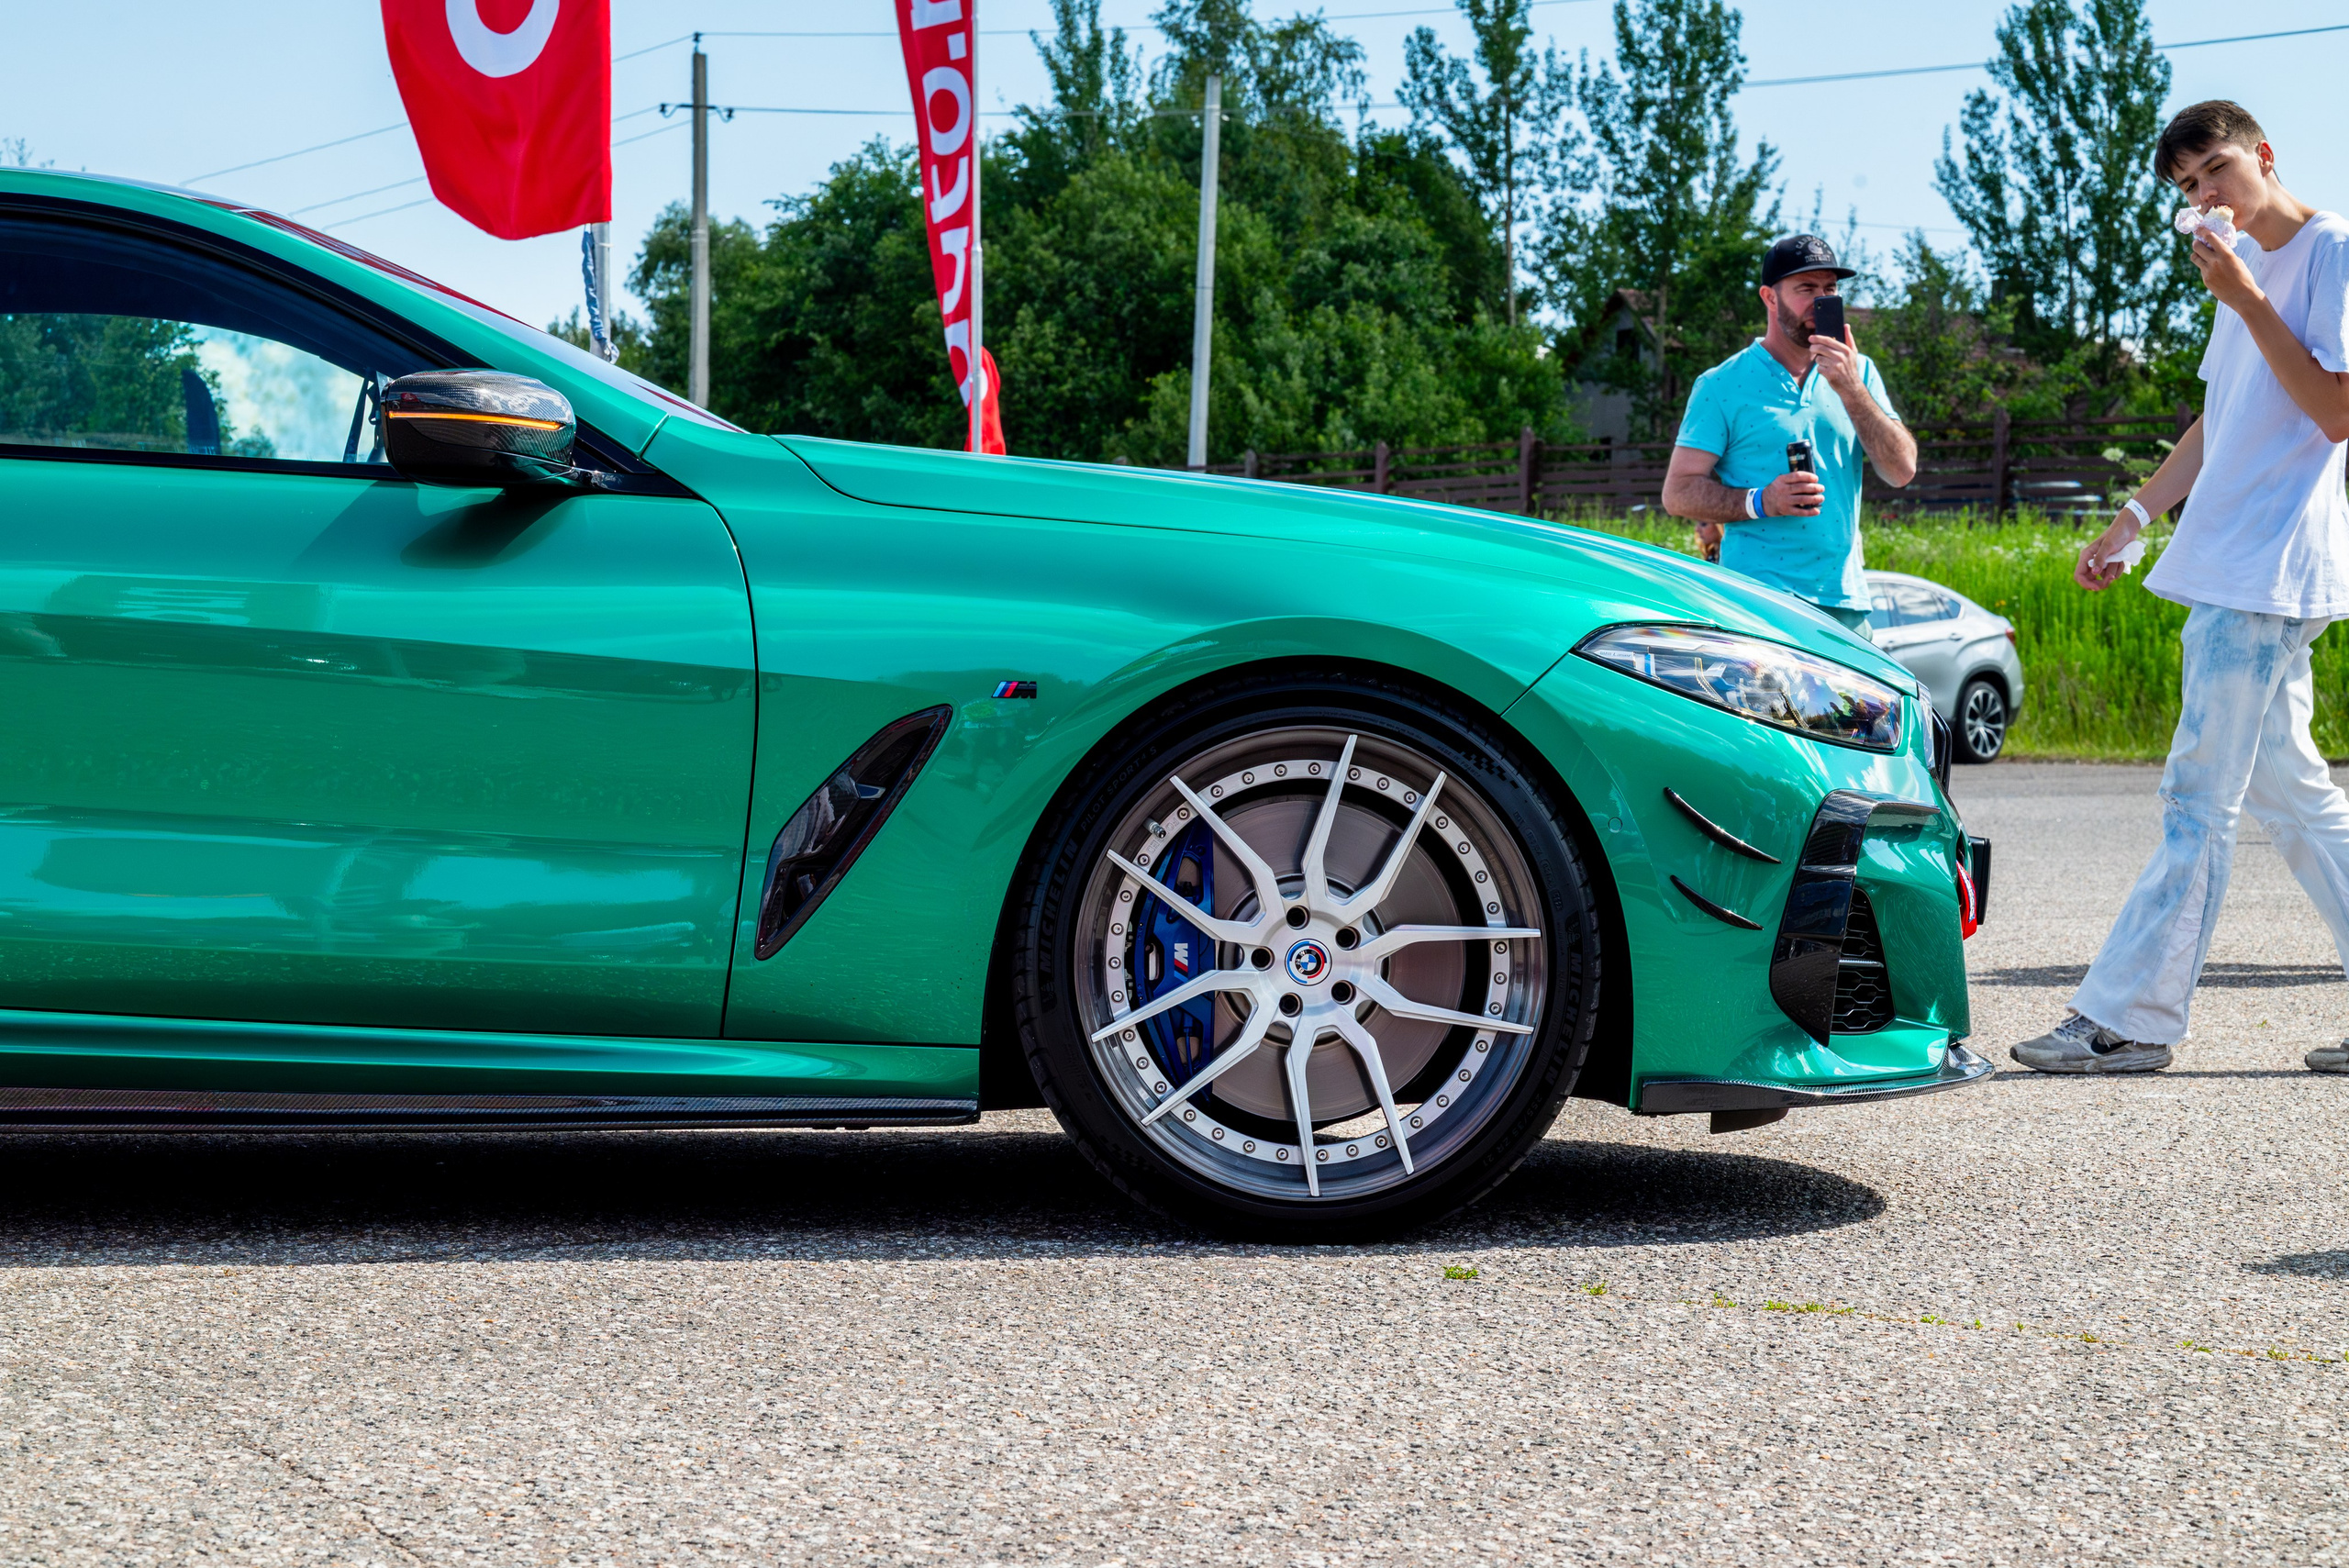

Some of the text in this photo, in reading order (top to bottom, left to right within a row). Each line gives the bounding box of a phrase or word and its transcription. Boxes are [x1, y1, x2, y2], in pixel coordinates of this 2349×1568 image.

[1146, 817, 1180, 854] FOED
[1038, 837, 1081, 974] MICHELIN
[1080, 796, 1107, 831] PILOT
[1543, 950, 1582, 1086] MICHELIN
[1511, 1092, 1543, 1138] 255/35
[1481, 1151, 1496, 1168] 21
[1494, 1137, 1513, 1155] ZR
